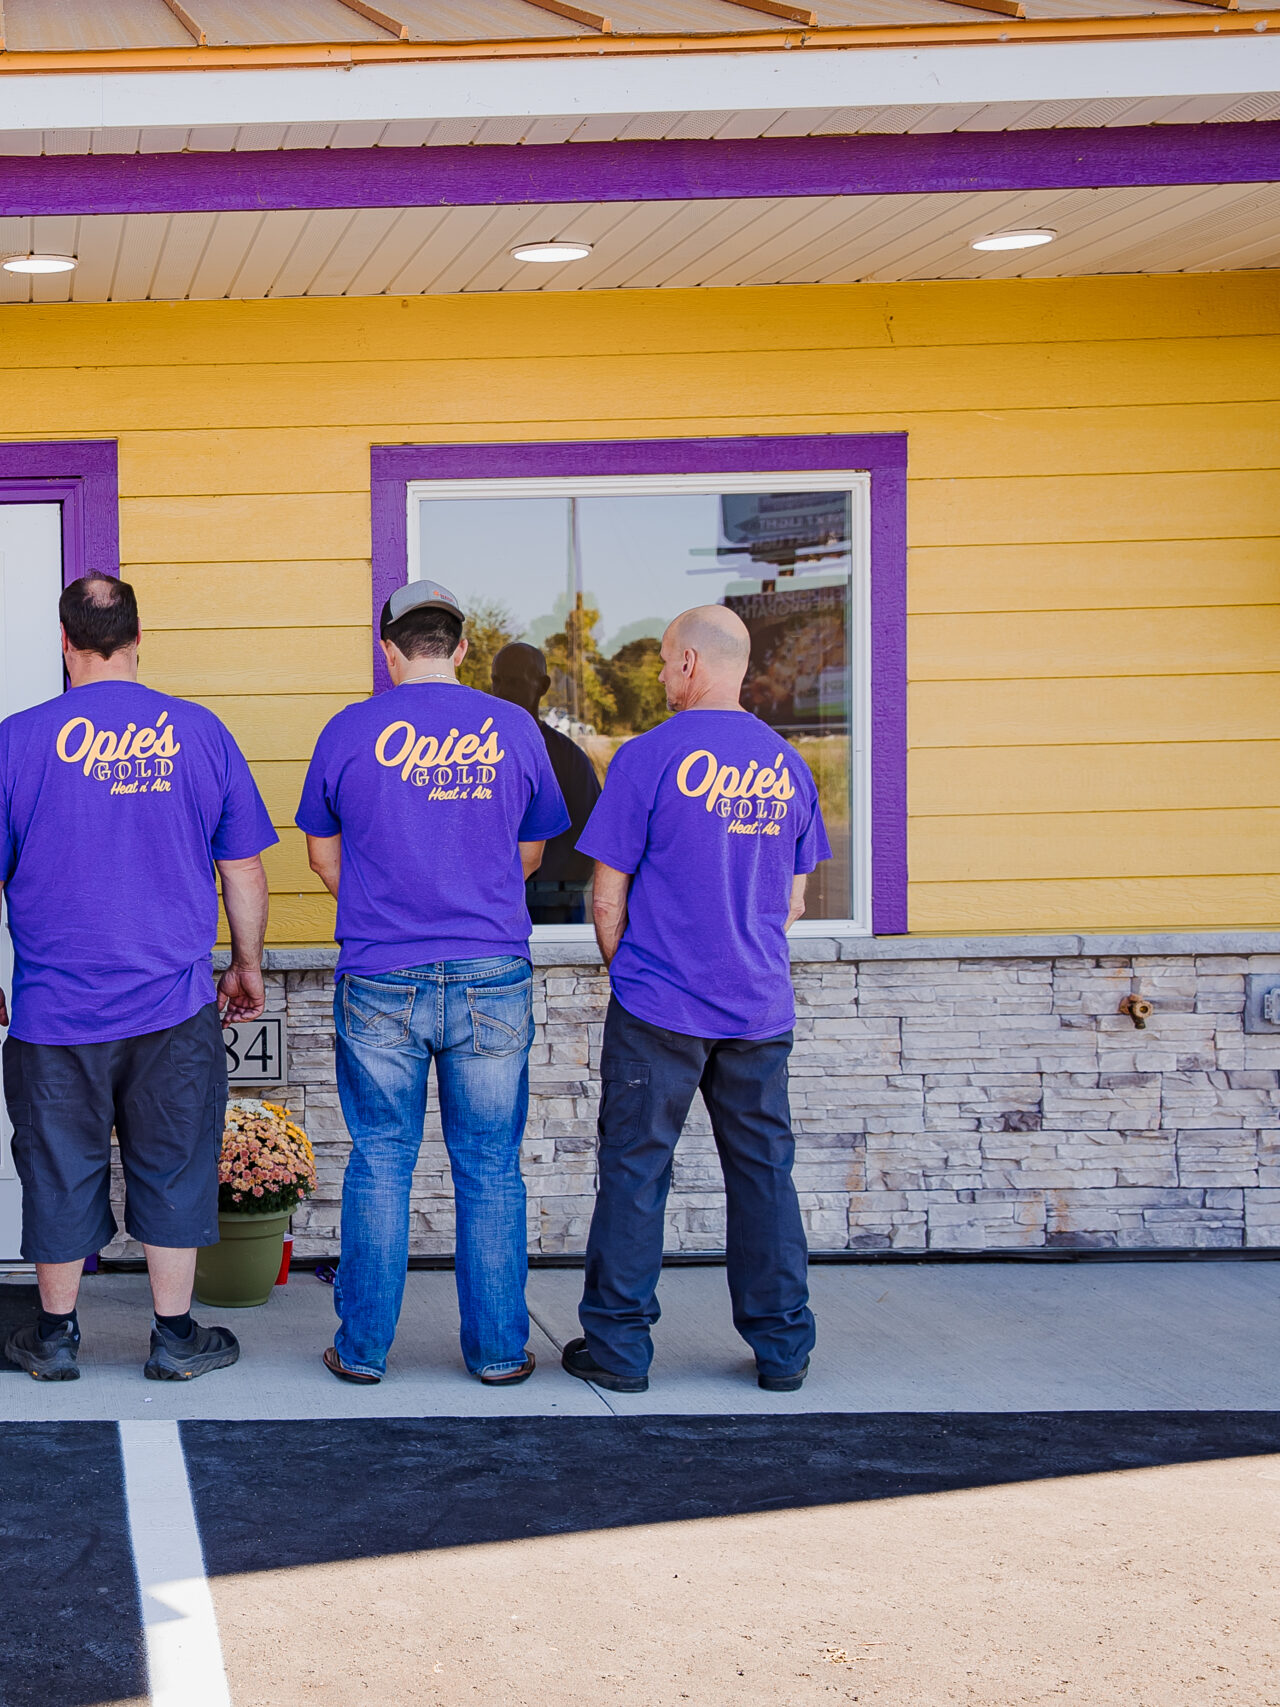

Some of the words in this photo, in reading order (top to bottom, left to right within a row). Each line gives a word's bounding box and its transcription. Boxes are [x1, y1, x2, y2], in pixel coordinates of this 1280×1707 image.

[56, 711, 181, 777] Opie's
[374, 717, 505, 782] Opie's
[93, 758, 174, 782] GOLD
[411, 765, 497, 787] GOLD
[110, 779, 139, 795] Heat
[150, 777, 172, 792] Air
[427, 786, 460, 801] Heat
[471, 784, 493, 800] Air
[676, 752, 796, 813] Opie's
[715, 797, 788, 820] GOLD
[727, 819, 759, 835] Heat
[761, 820, 781, 836] Air
